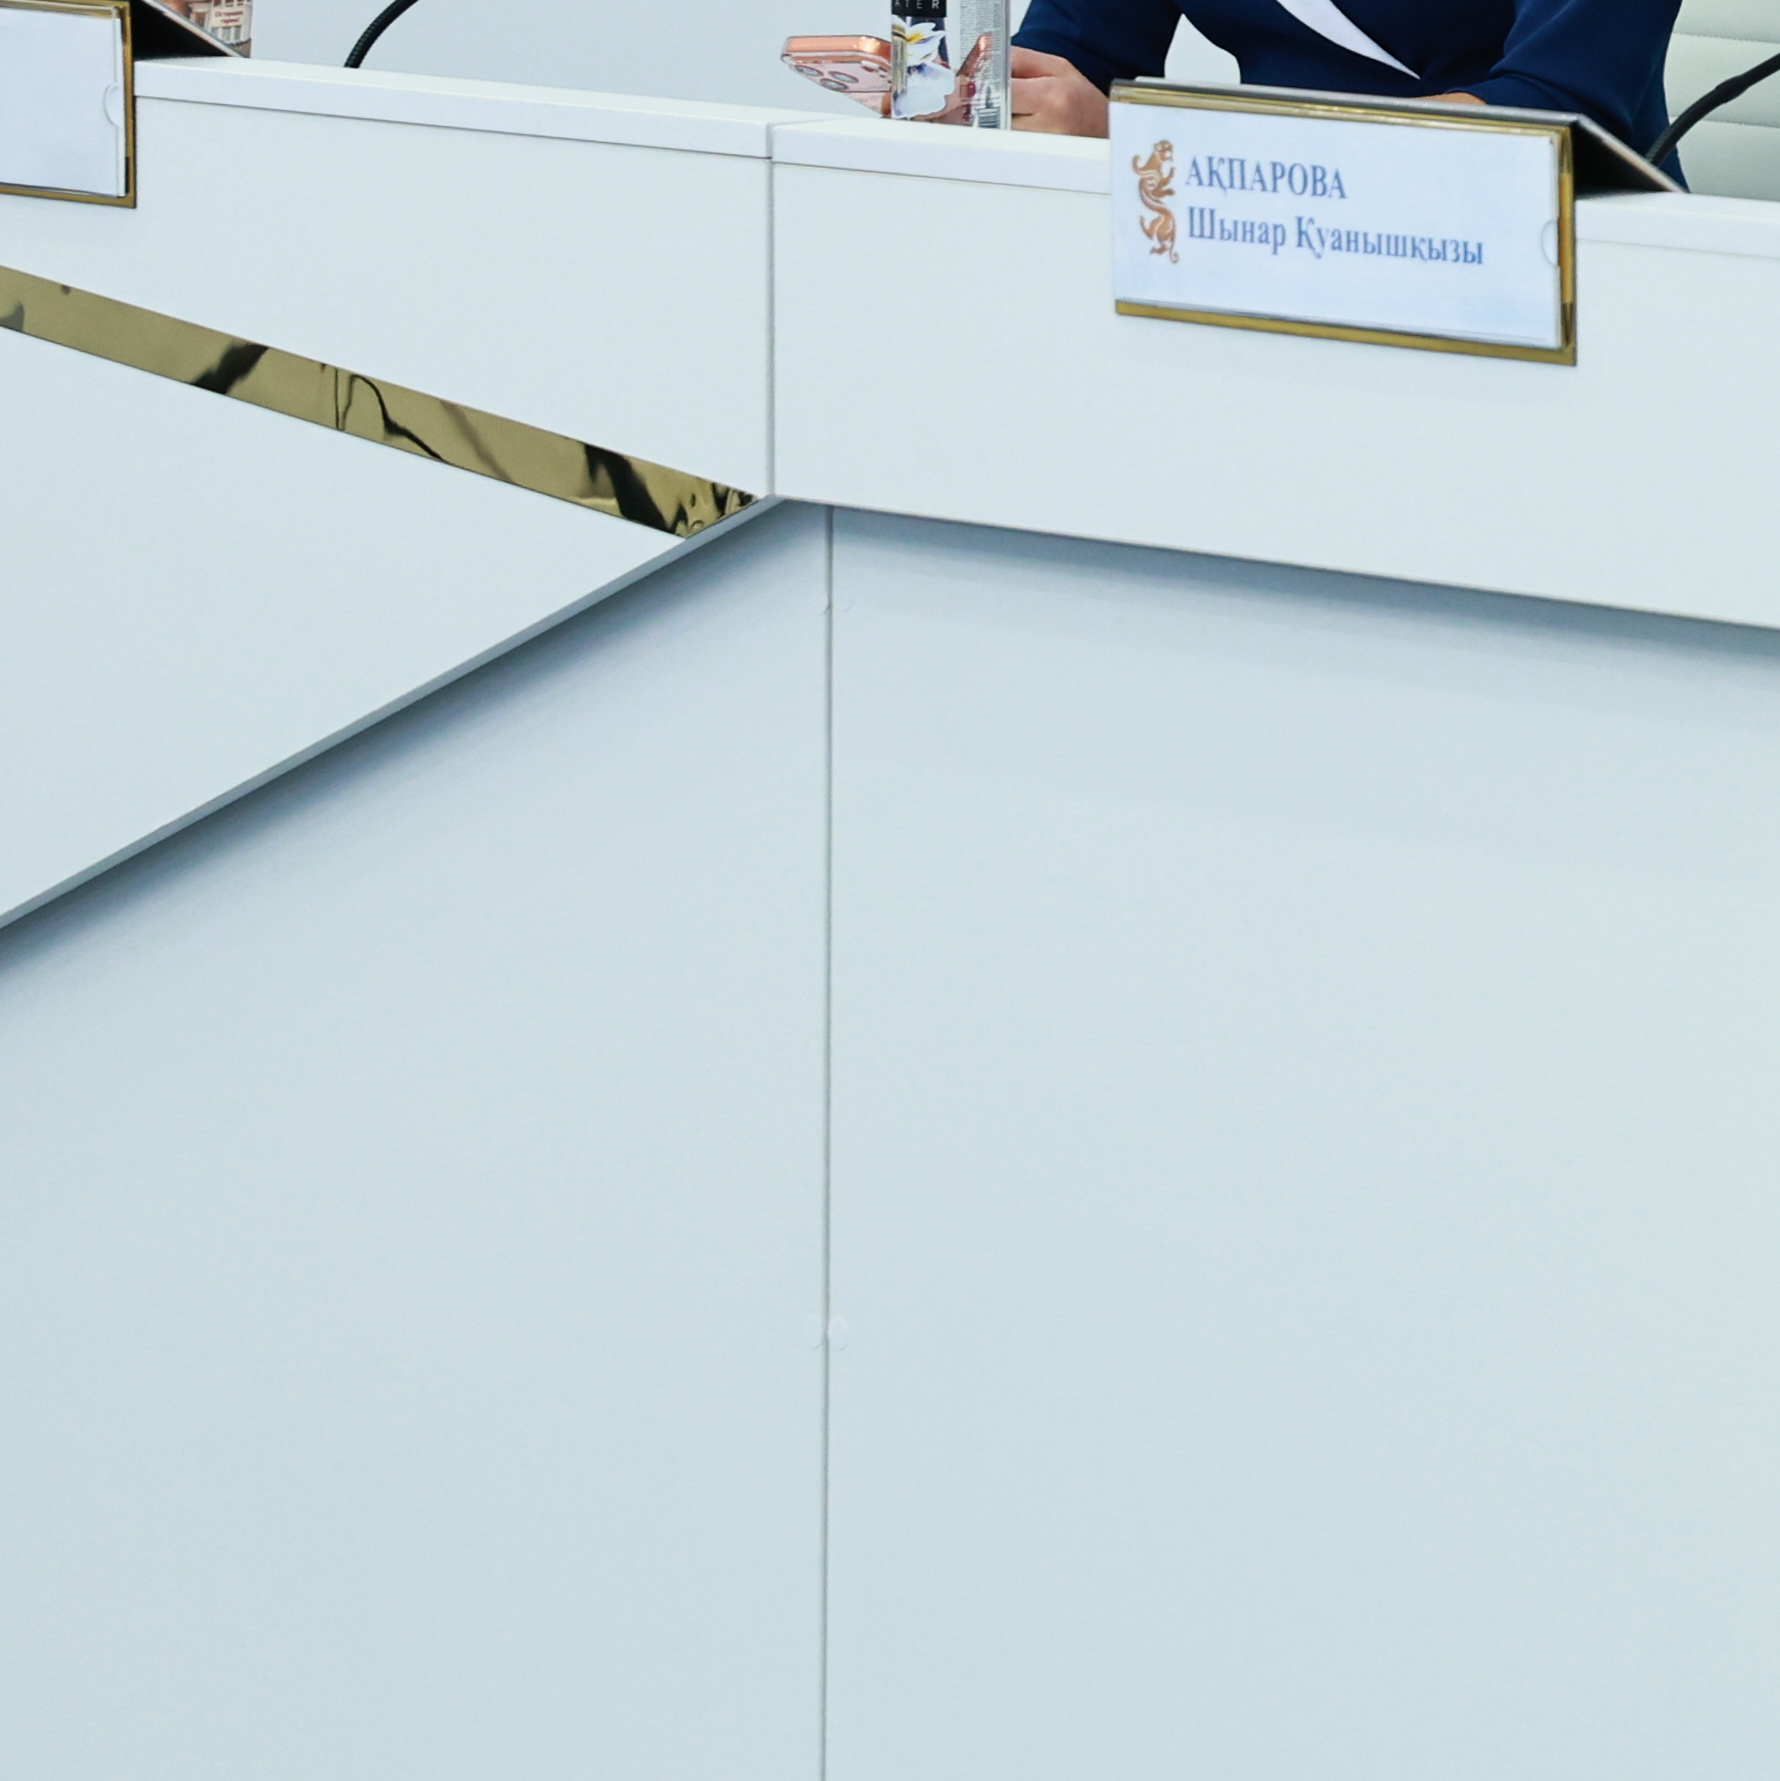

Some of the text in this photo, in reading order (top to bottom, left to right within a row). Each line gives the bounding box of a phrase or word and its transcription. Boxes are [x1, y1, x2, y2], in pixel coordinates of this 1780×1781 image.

[1185, 155, 1347, 200] АҚПАРОВА
[1187, 206, 1484, 266] Шынар Қуанышқызы
